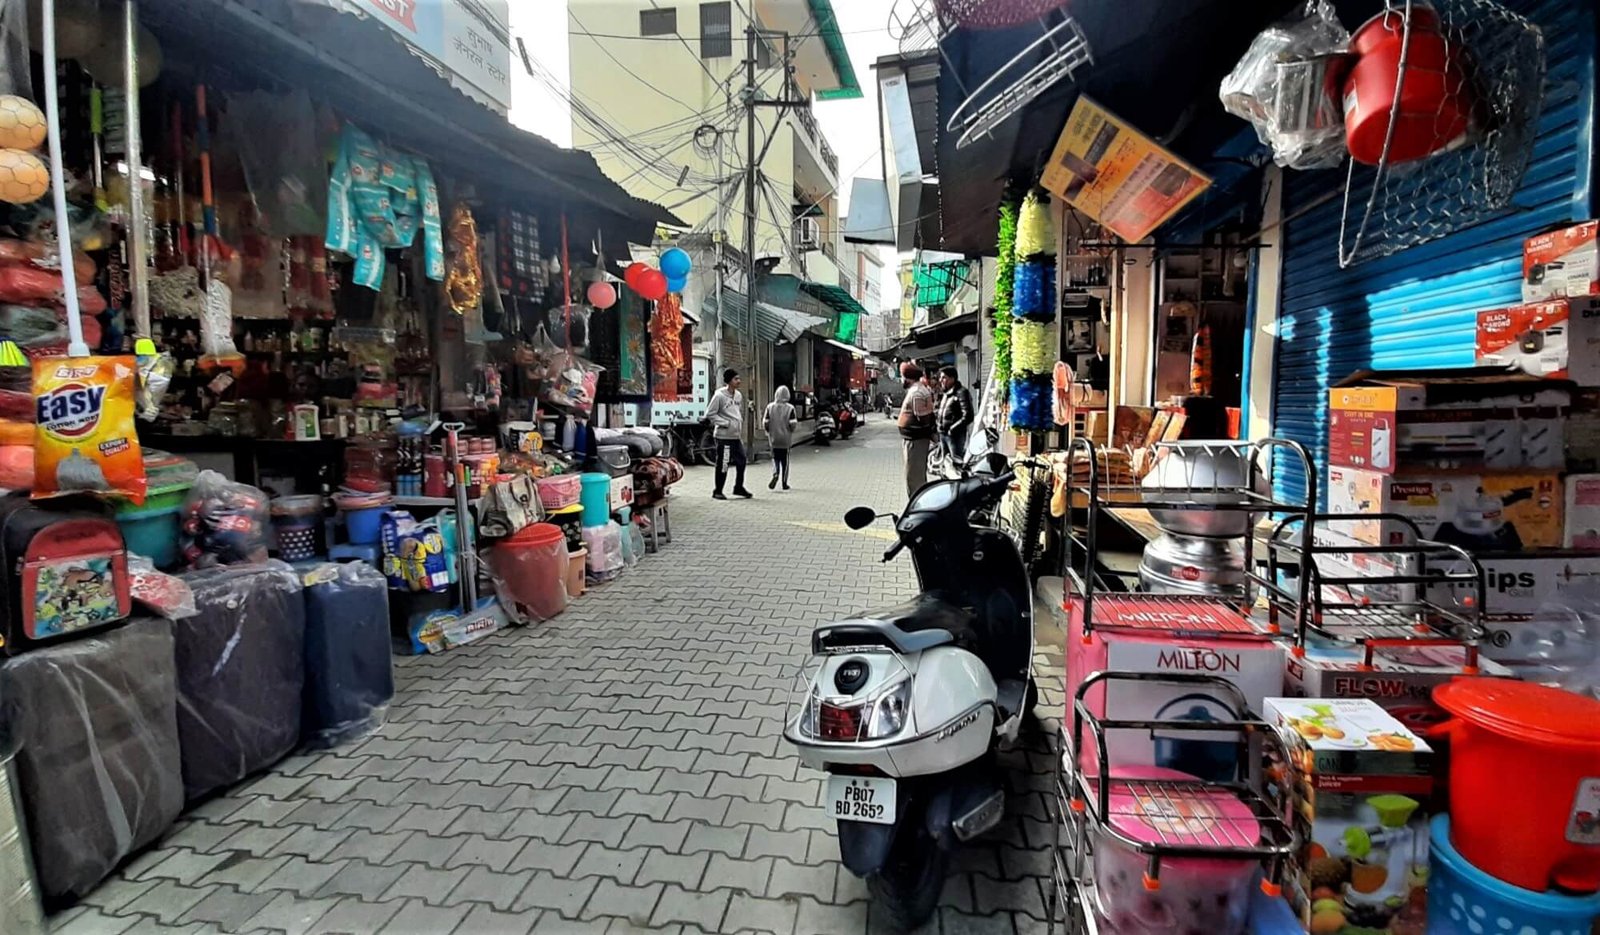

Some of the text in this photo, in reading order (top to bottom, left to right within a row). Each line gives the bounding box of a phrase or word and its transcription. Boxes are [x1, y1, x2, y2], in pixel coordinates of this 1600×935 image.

[1526, 241, 1553, 254] DIAMOND
[1530, 236, 1550, 246] BLACK
[1482, 317, 1511, 329] DIAMOND
[1486, 313, 1507, 322] BLACK
[37, 386, 106, 424] Easy
[100, 438, 128, 450] EXPORT
[104, 443, 130, 457] QUALITY
[1391, 484, 1430, 495] Prestige
[1157, 649, 1240, 672] MILTON
[1334, 677, 1402, 699] FLOW
[844, 786, 875, 803] PB07
[835, 800, 884, 819] BD 2652
